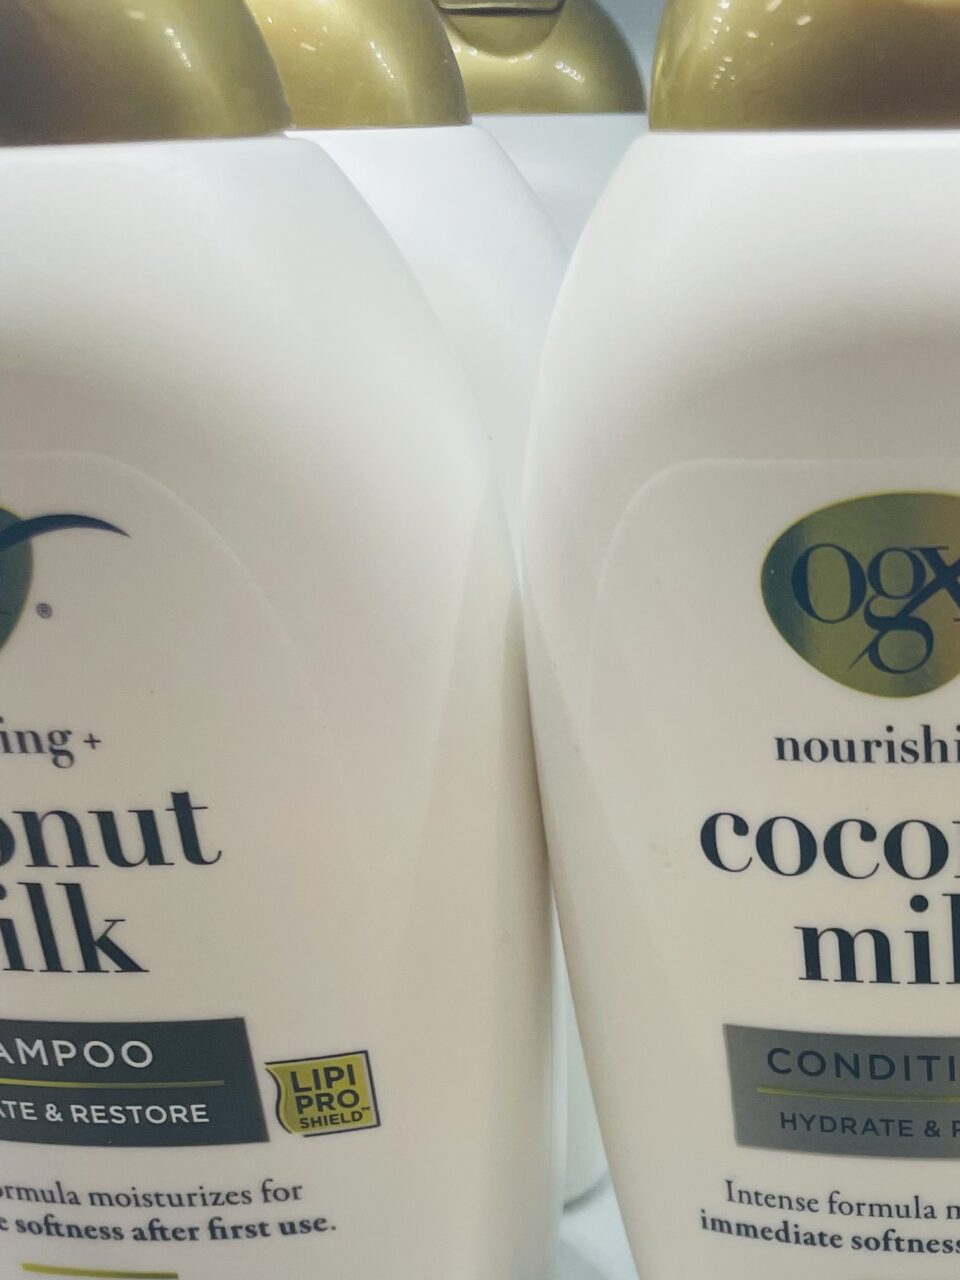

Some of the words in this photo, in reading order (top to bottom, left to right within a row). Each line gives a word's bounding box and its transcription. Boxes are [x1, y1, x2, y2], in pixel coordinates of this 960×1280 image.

[0, 791, 222, 868] nut
[290, 1063, 357, 1094] LIPI
[0, 1100, 38, 1121] TE
[45, 1103, 64, 1122] &
[70, 1104, 210, 1124] RESTORE
[297, 1088, 360, 1115] PRO
[780, 1112, 914, 1138] HYDRATE
[924, 1119, 941, 1138] &
[0, 1180, 82, 1206] rmula
[89, 1186, 252, 1208] moisturizes
[261, 1178, 303, 1204] for
[725, 1179, 819, 1214] Intense
[828, 1191, 937, 1220] formula
[15, 1213, 124, 1241] softness
[132, 1217, 200, 1242] after
[208, 1215, 270, 1241] first
[280, 1213, 337, 1235] use.
[700, 1209, 843, 1250] immediate
